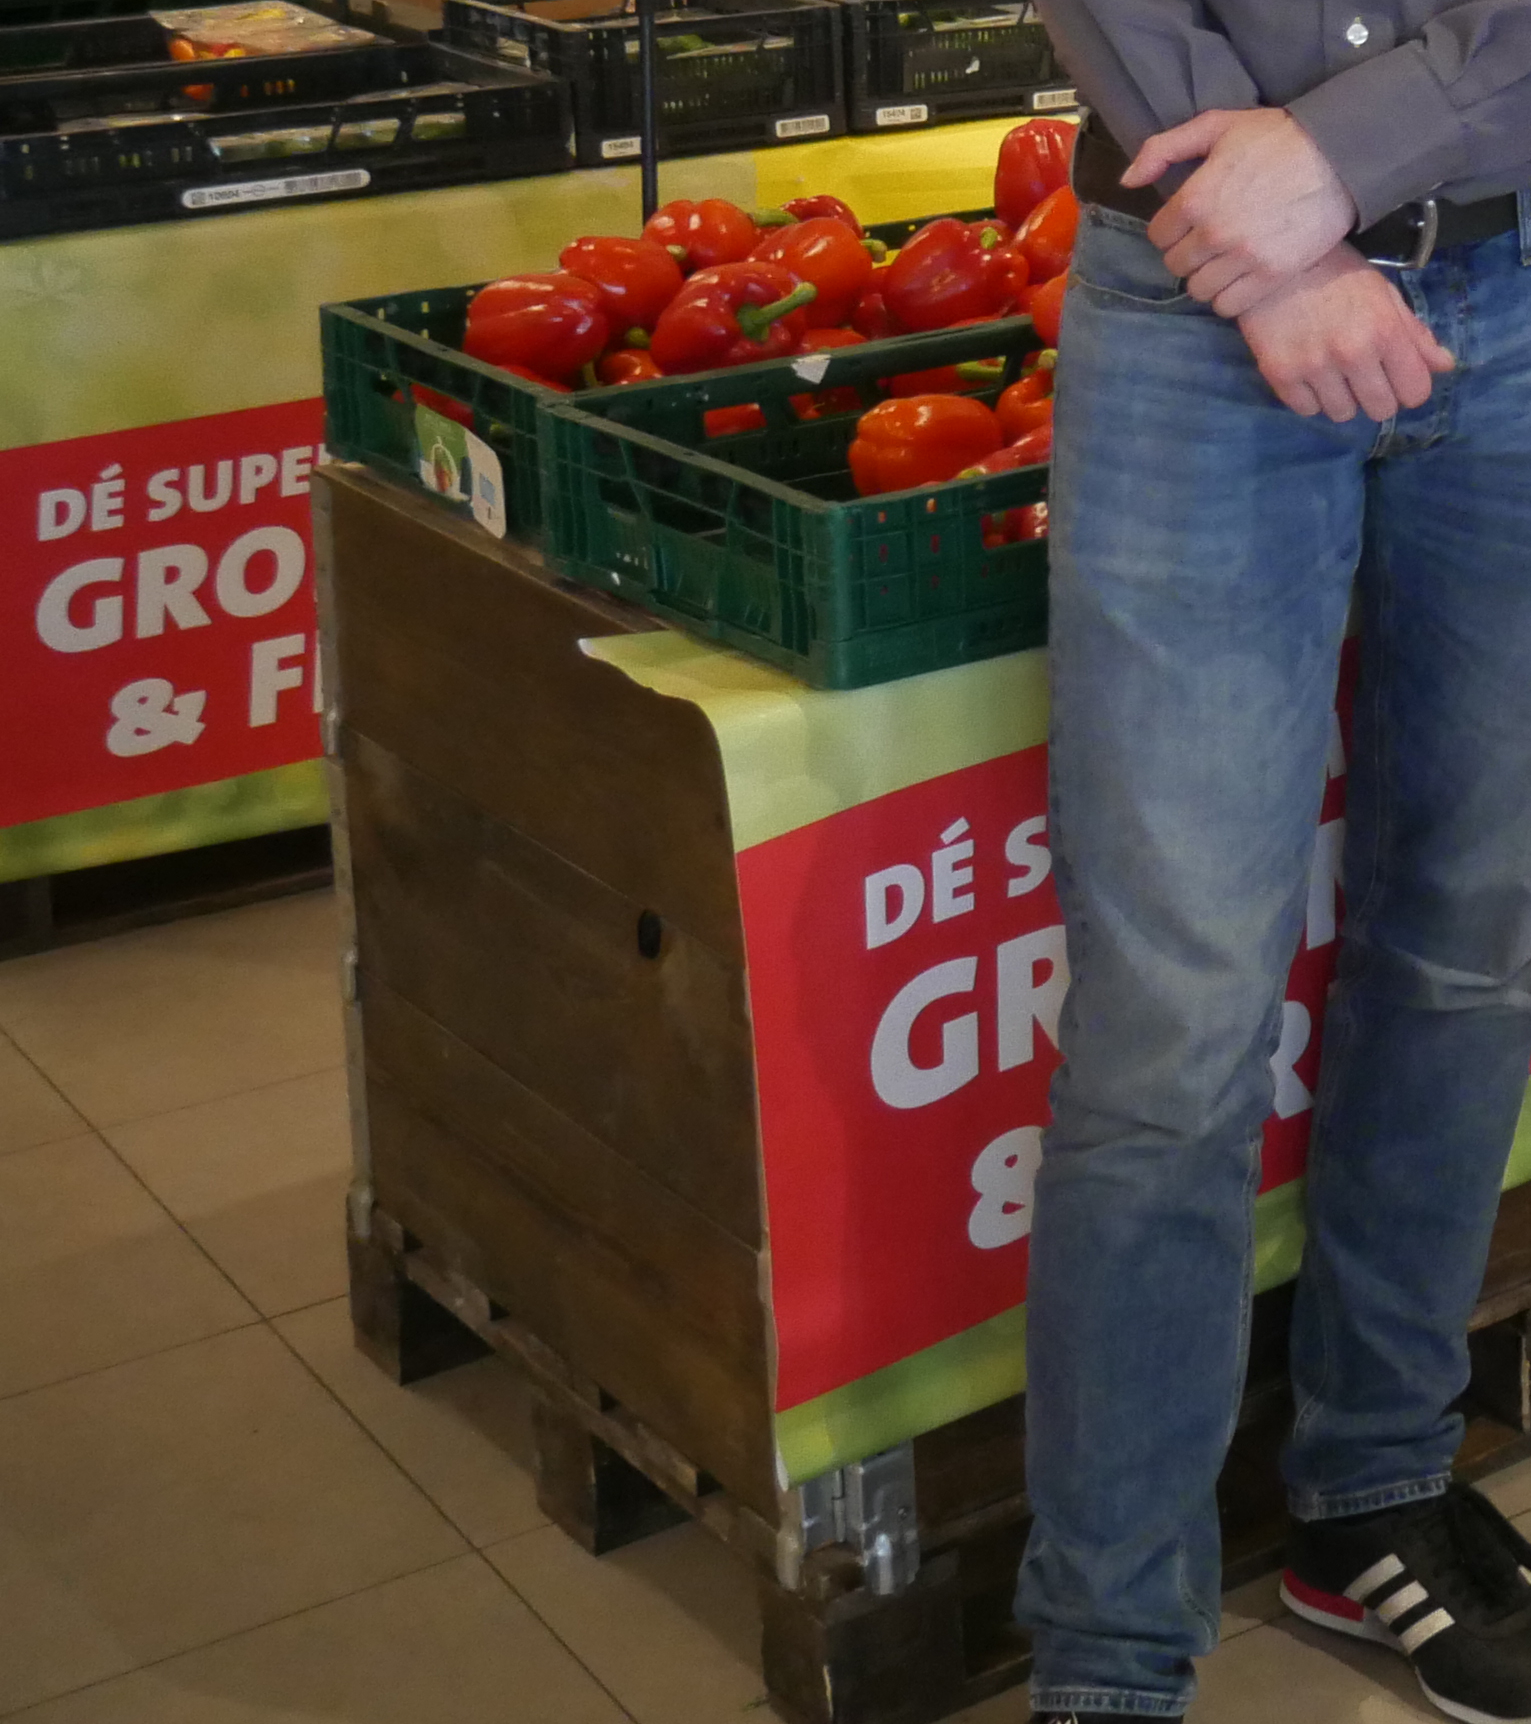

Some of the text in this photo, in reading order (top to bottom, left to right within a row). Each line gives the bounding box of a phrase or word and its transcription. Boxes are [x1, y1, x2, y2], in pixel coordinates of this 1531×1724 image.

[37, 463, 125, 542] DÉ
[105, 630, 323, 758] & F
[864, 817, 975, 951] DÉ
